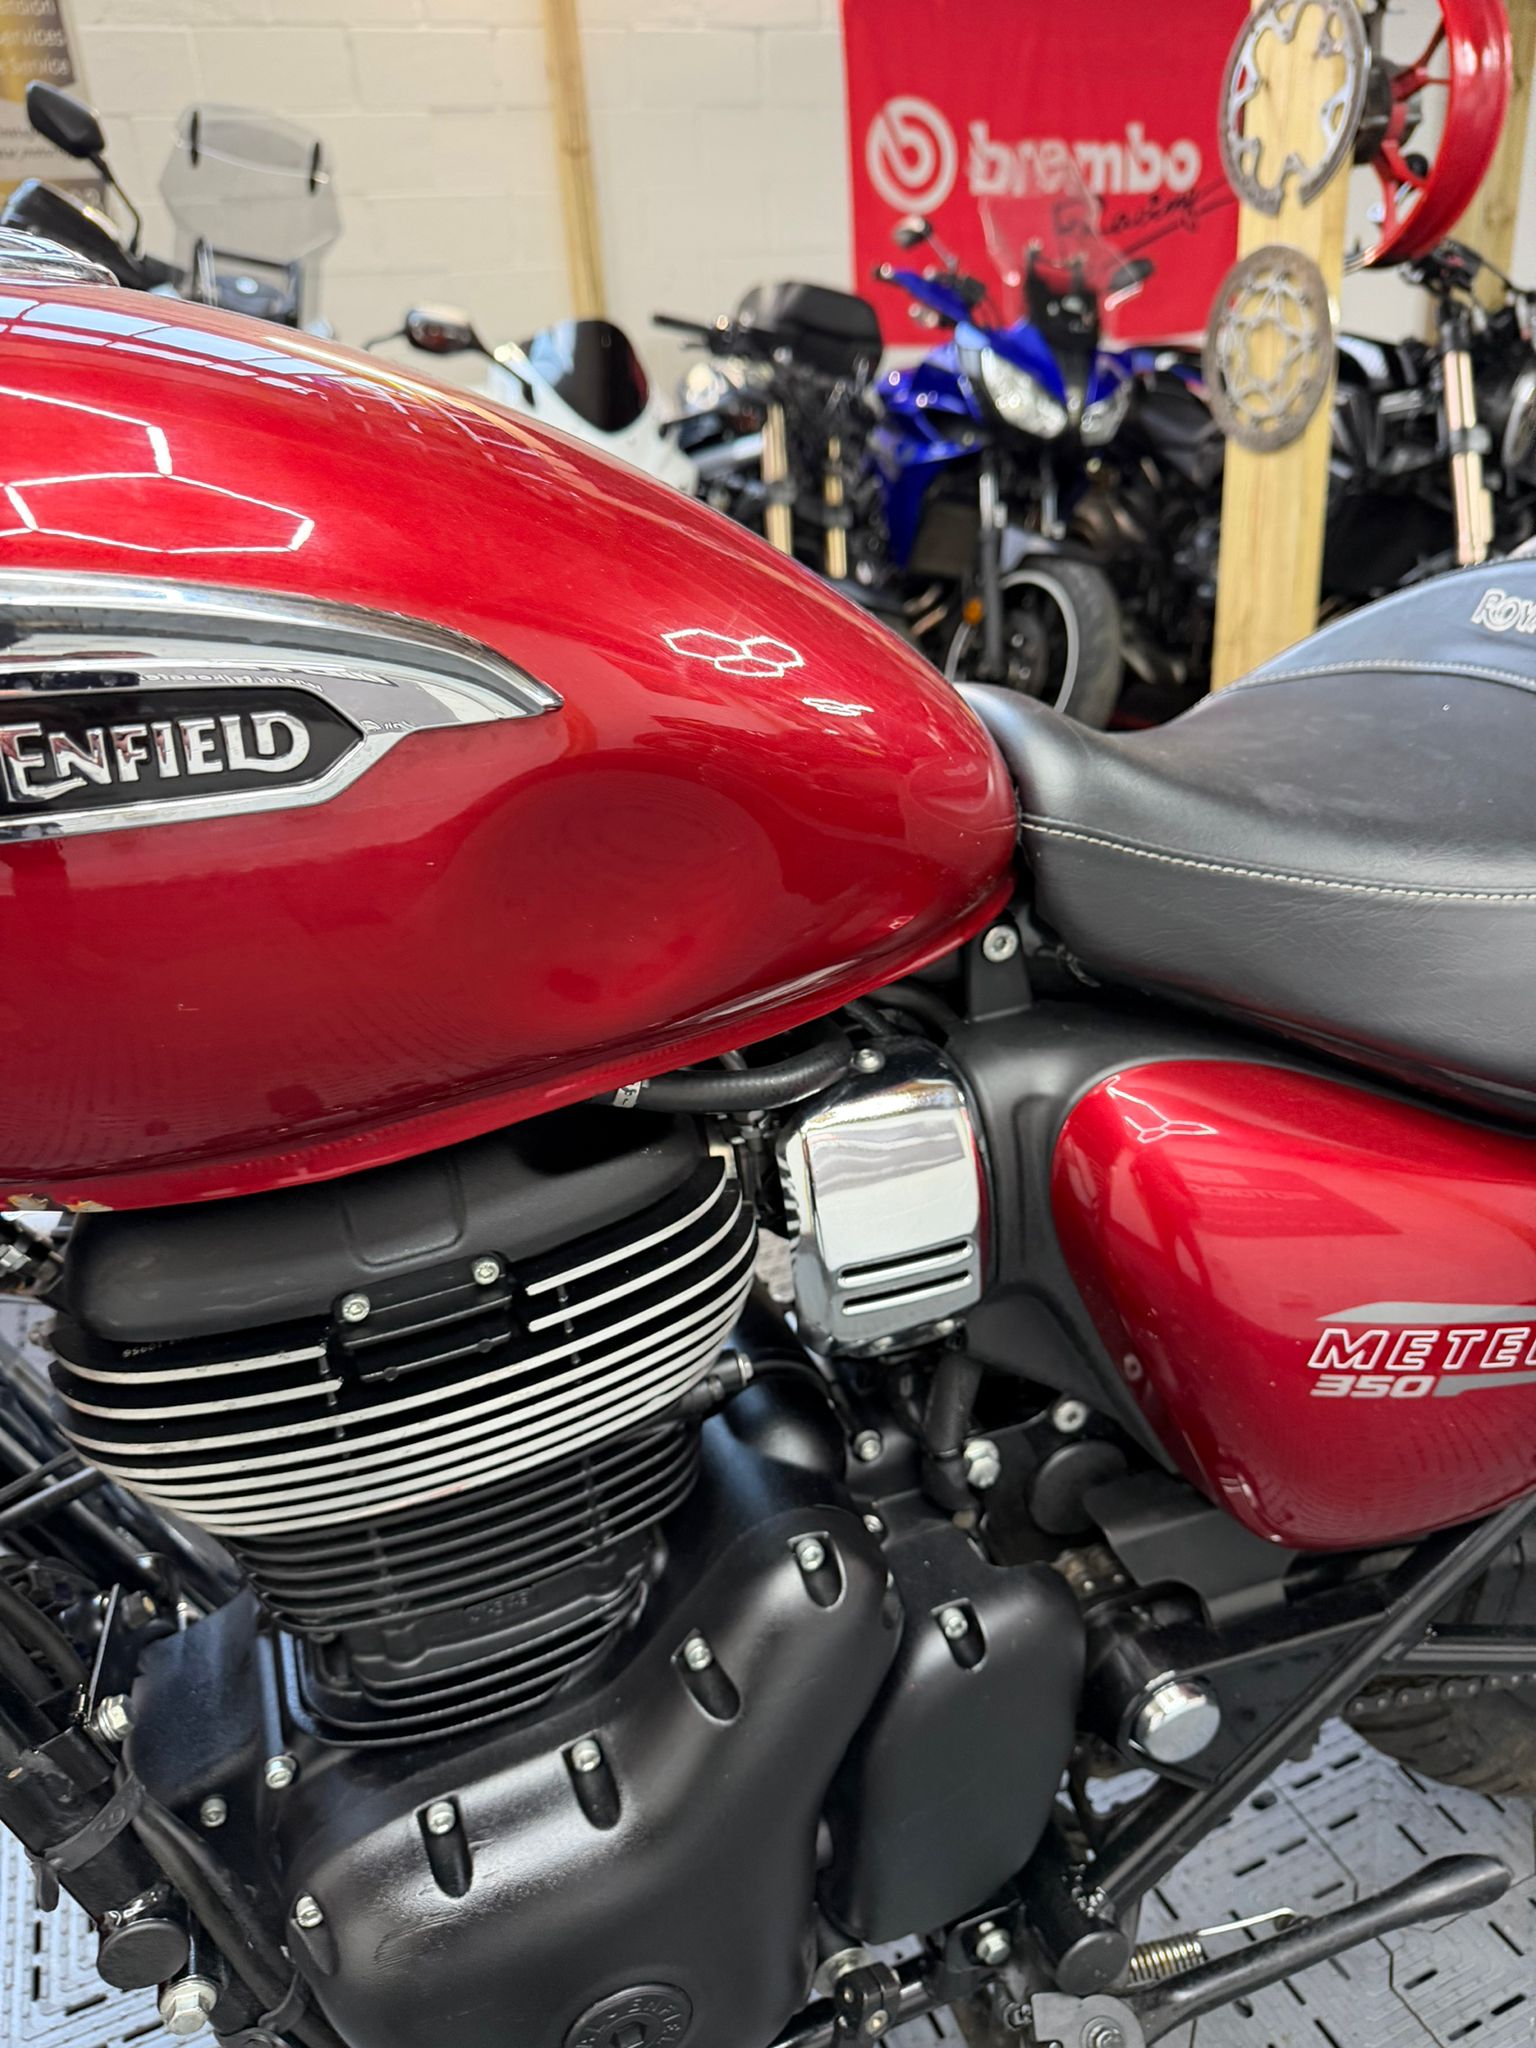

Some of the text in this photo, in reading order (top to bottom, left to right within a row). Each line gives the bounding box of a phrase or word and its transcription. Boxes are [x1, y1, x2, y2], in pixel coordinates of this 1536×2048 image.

[969, 121, 1201, 196] brembo
[0, 711, 310, 801] ENFIELD
[1307, 1327, 1536, 1371] METE
[1309, 1373, 1436, 1398] 350
